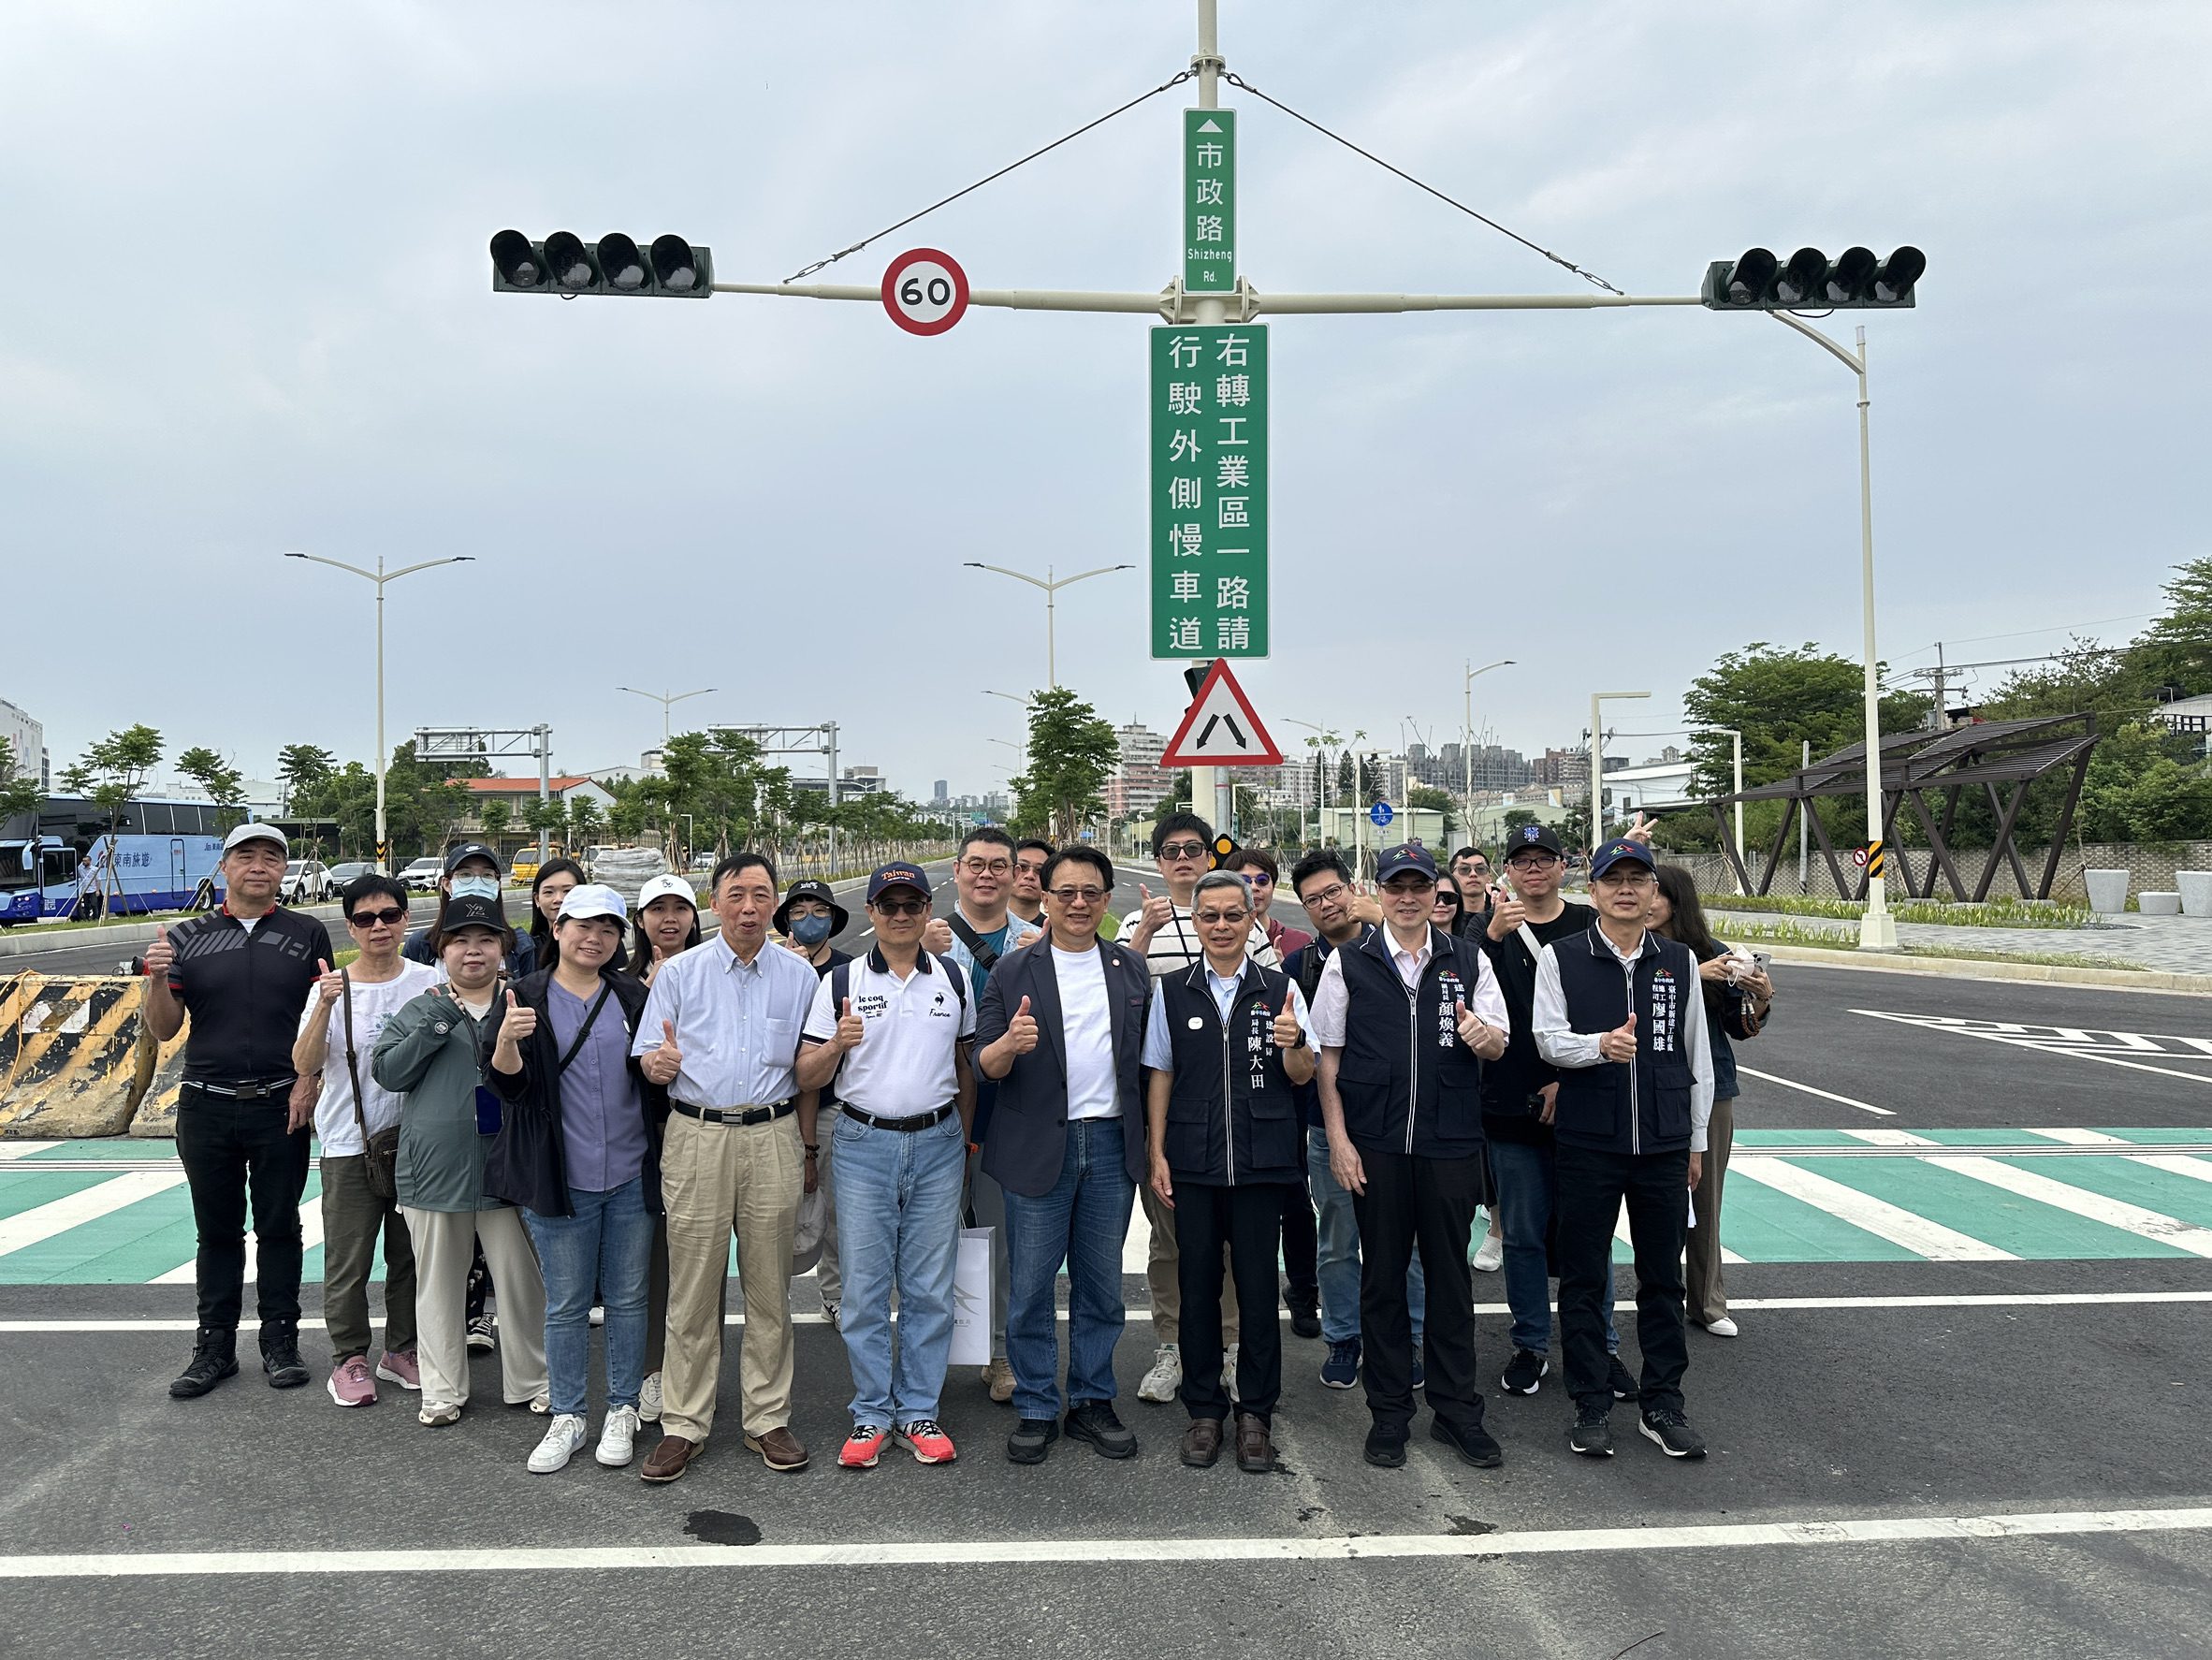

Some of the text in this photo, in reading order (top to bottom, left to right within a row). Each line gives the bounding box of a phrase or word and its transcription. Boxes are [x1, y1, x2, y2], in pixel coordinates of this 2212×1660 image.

[1196, 141, 1224, 241] 市政路
[1187, 248, 1232, 263] Shizheng
[1203, 270, 1217, 283] Rd.
[900, 277, 951, 306] 60
[1168, 335, 1203, 650] 行駛外側慢車道
[1215, 333, 1250, 650] 右轉工業區一路請
[881, 869, 916, 881] Taiwan
[857, 1000, 889, 1012] sportif
[858, 995, 884, 1003] le coq
[928, 1008, 952, 1018] France
[1652, 1001, 1666, 1052] 廖國雄
[1247, 1035, 1265, 1089] 陳大田
